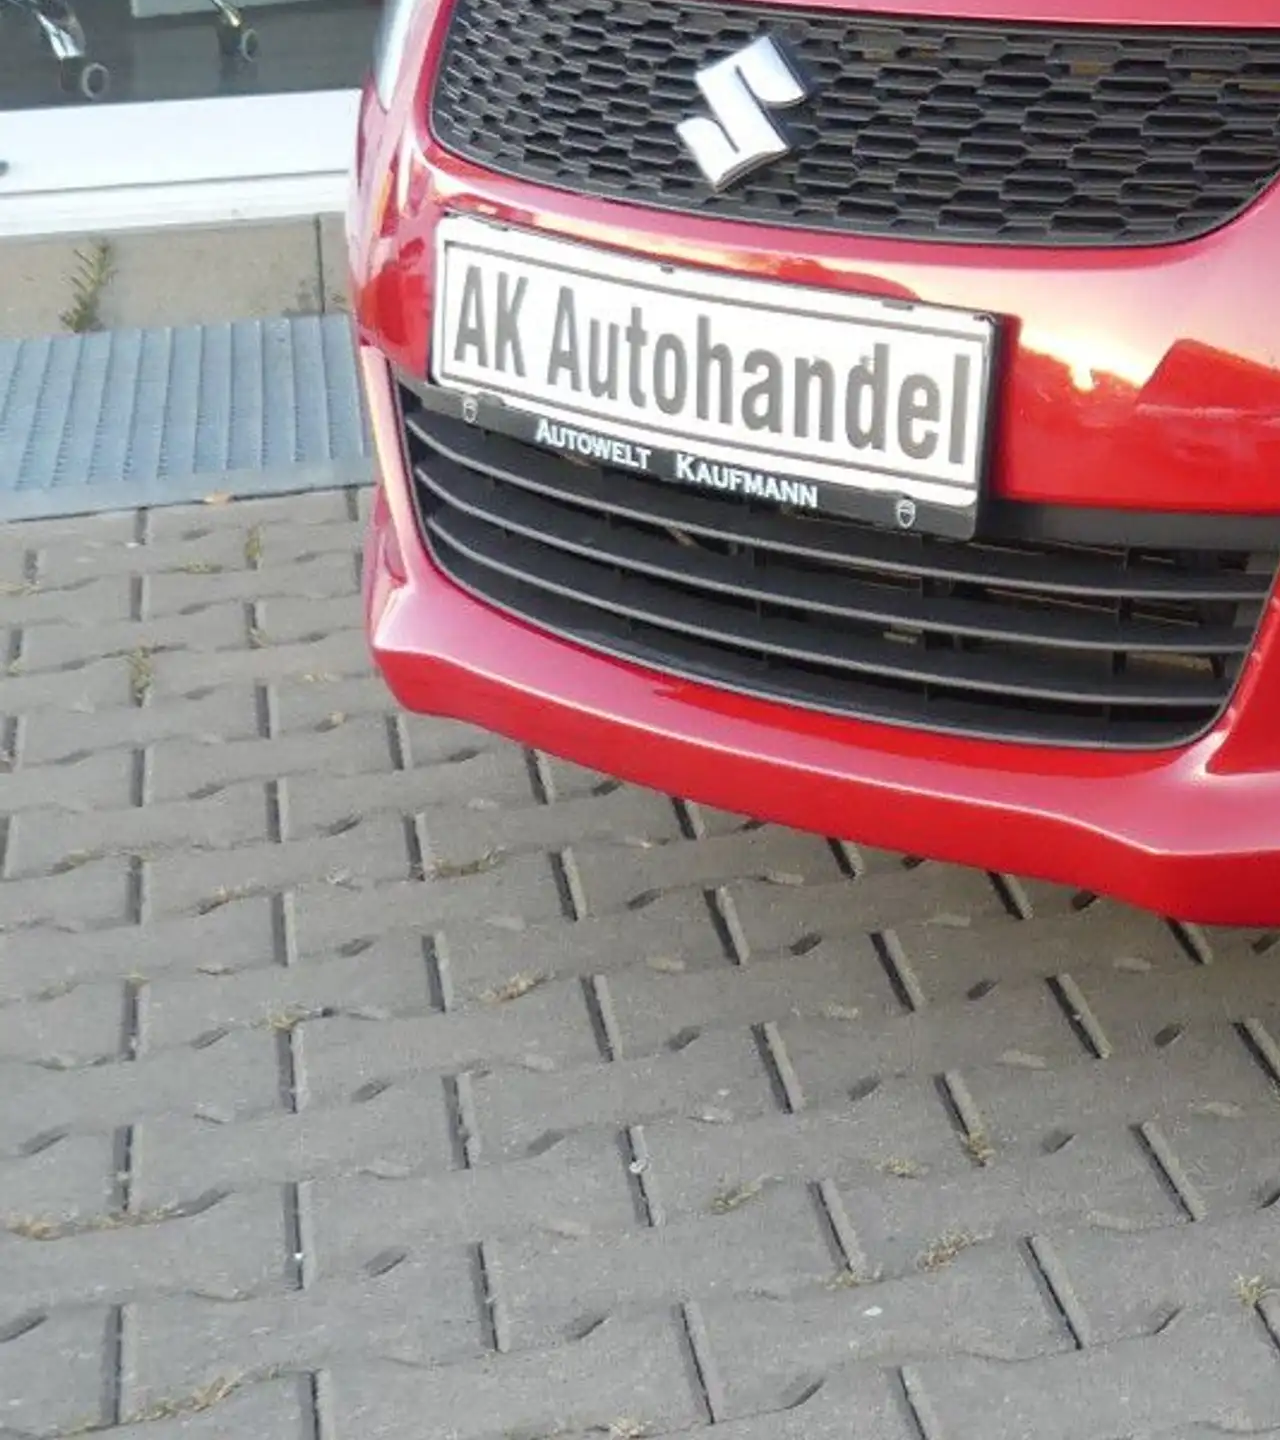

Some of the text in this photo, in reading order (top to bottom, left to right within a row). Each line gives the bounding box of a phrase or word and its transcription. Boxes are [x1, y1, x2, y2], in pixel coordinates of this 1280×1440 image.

[453, 264, 971, 465] AK Autohandel
[534, 418, 819, 509] AUTOWELT KAUFMANN
